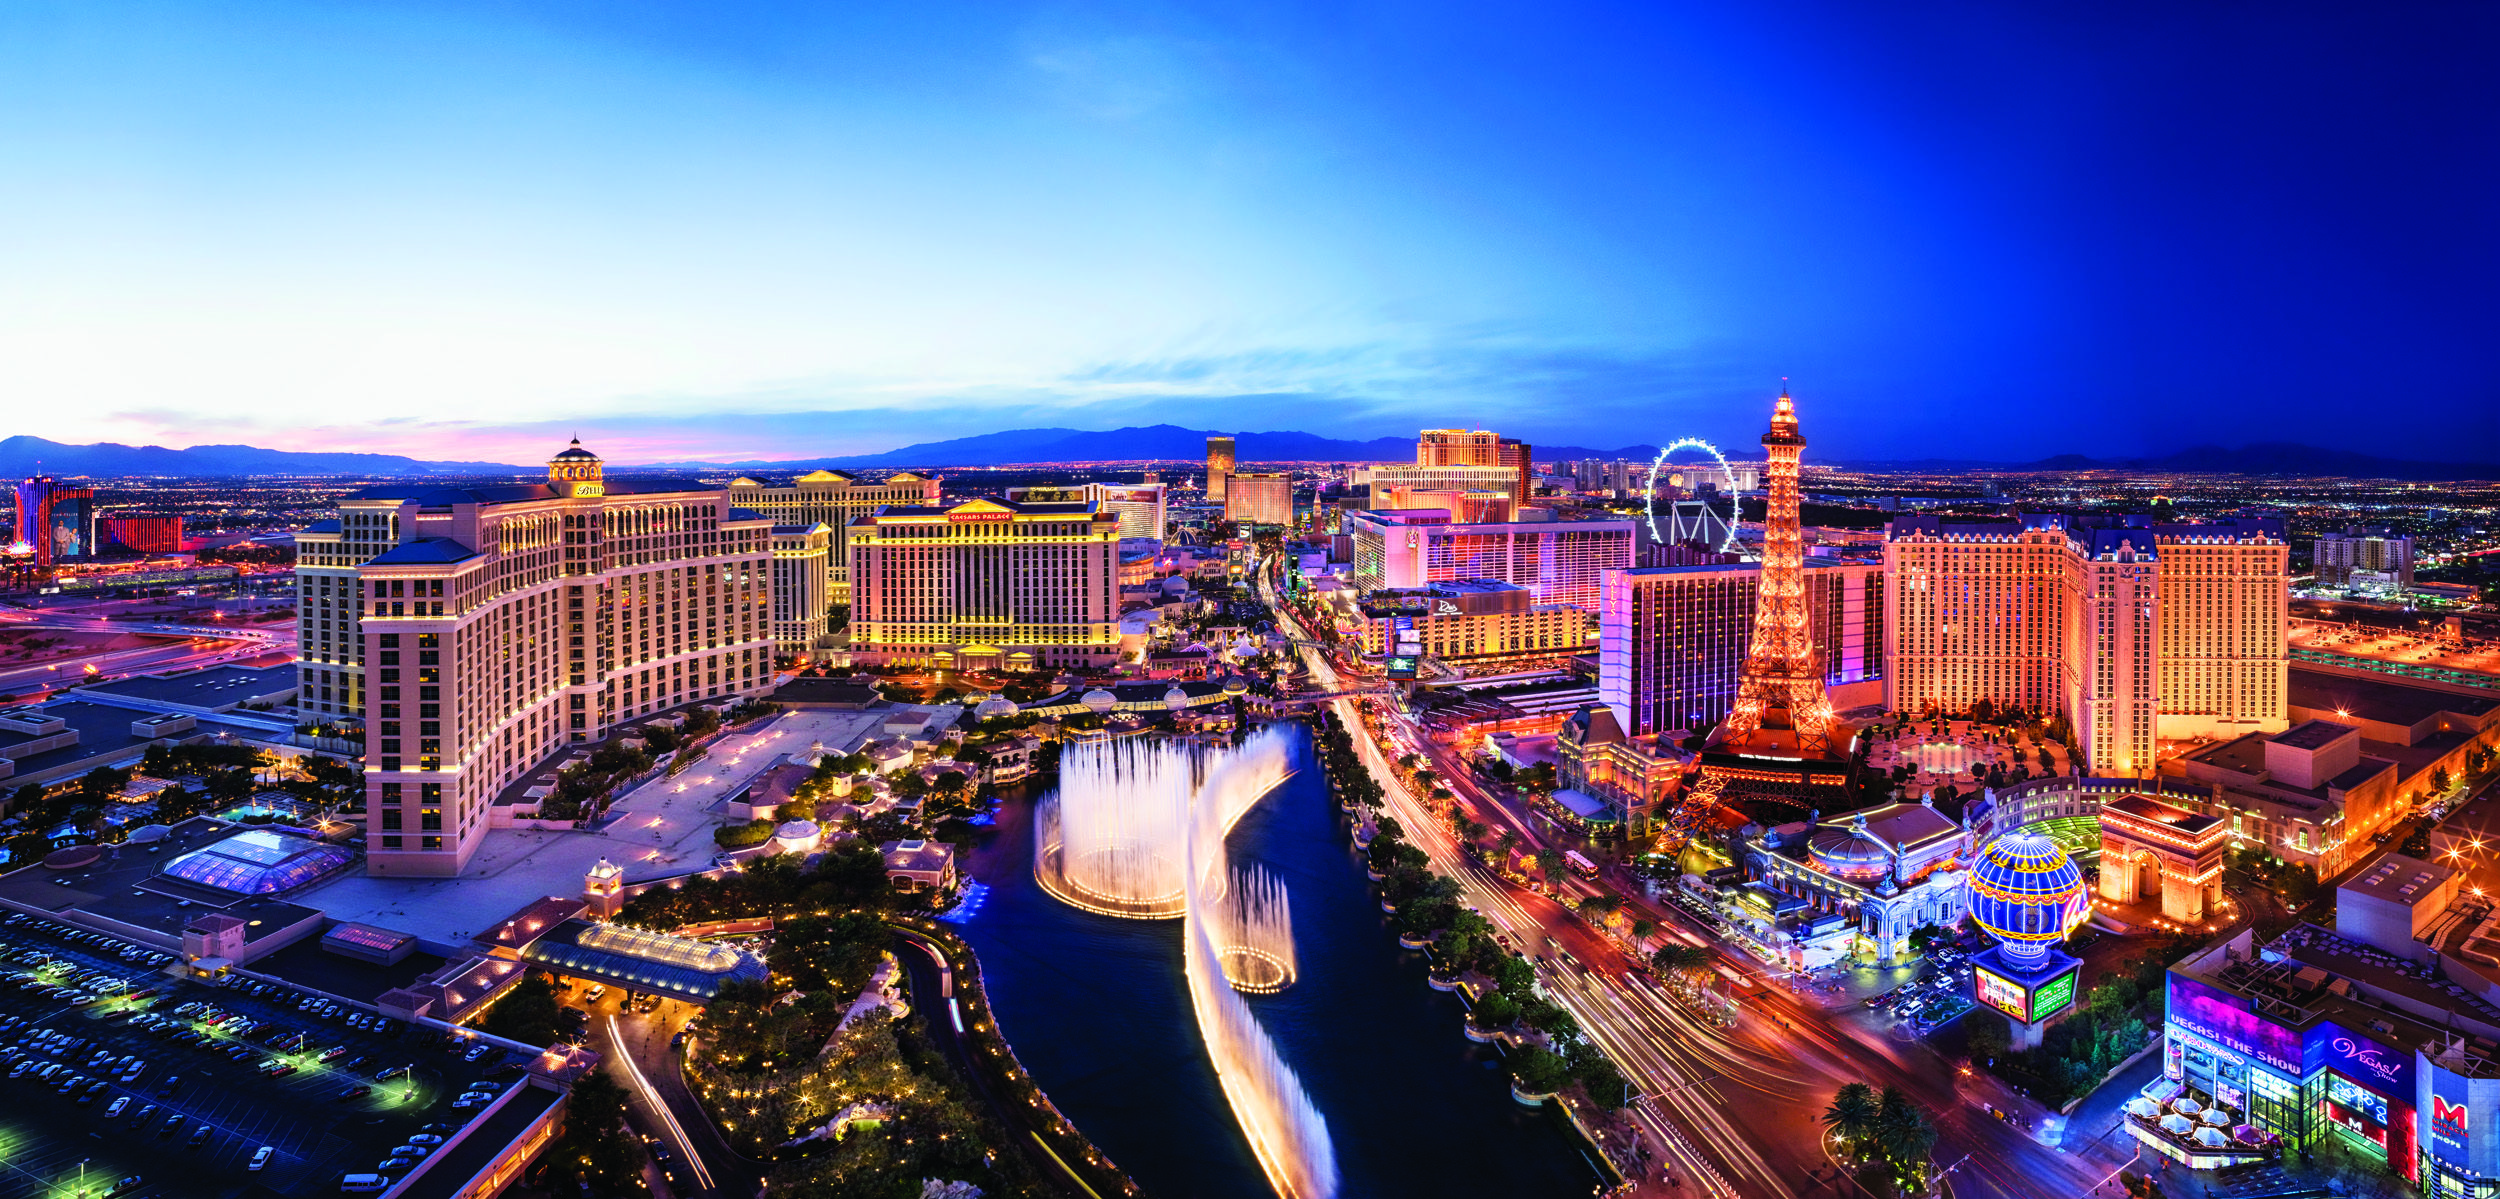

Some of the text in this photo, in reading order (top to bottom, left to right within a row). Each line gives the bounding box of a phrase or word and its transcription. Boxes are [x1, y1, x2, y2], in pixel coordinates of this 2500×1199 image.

[2170, 1013, 2221, 1042] VEGAS!
[2223, 1035, 2254, 1056] THE
[2256, 1050, 2301, 1075] SHOW
[2433, 1093, 2469, 1131] M
[2348, 1116, 2363, 1132] M
[2432, 1117, 2469, 1138] MIRACLE
[2432, 1125, 2450, 1137] MILE
[2431, 1132, 2461, 1149] SHOPS
